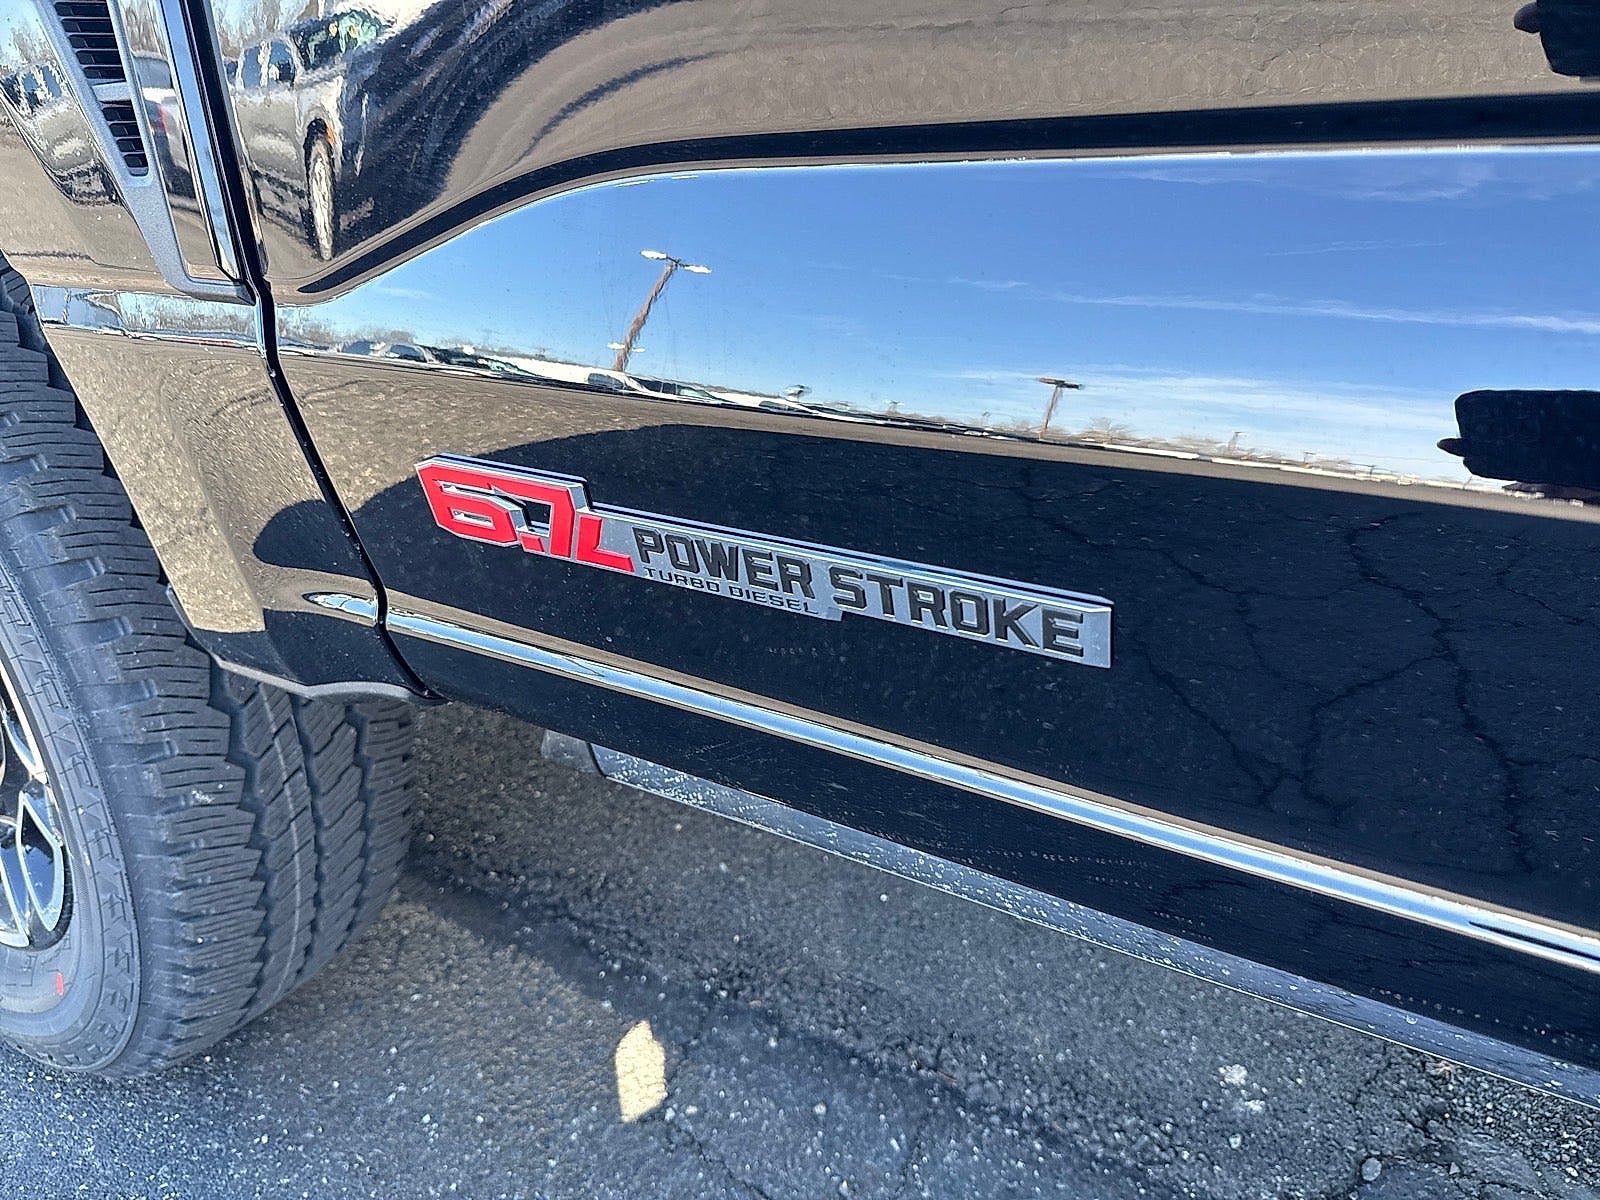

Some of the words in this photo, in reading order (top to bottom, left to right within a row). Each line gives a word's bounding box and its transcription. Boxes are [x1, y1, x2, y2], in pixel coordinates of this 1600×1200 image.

[632, 526, 815, 601] POWER
[829, 566, 1085, 658] STROKE
[644, 567, 720, 593] TURBO
[730, 586, 819, 616] DIESEL
